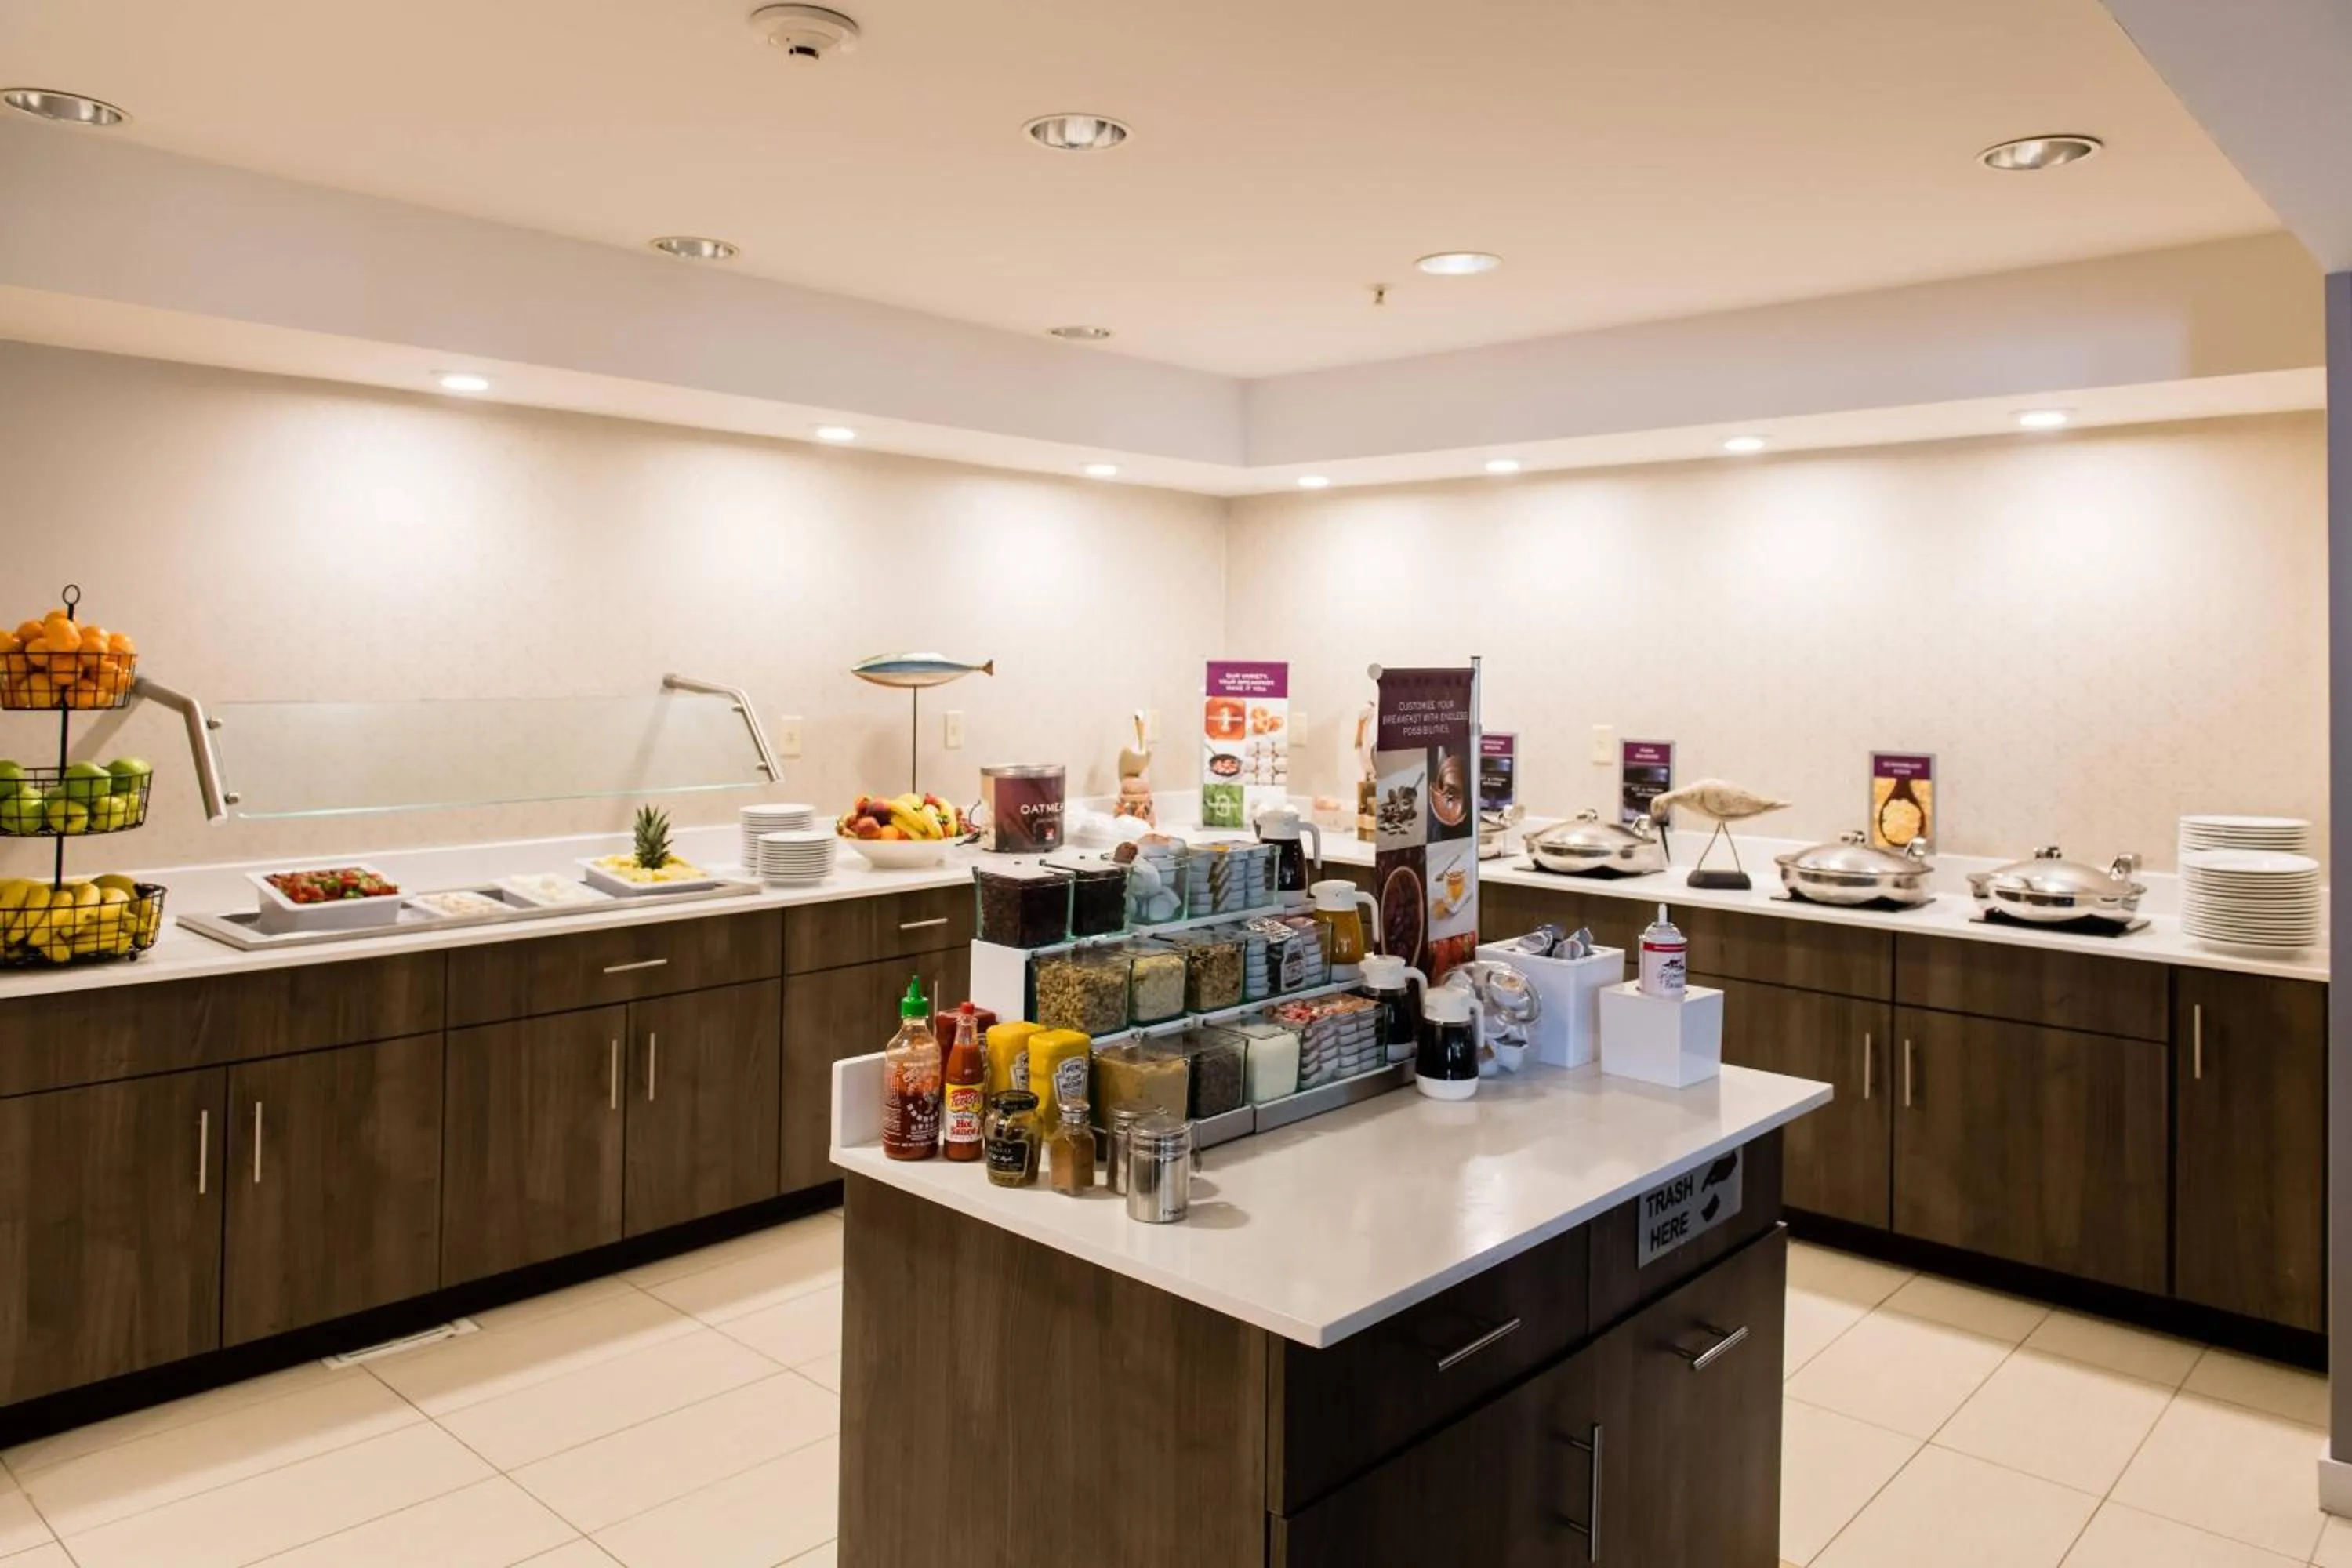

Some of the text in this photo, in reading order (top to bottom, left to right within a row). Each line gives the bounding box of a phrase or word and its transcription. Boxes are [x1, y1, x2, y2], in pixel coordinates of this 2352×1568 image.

[1398, 699, 1454, 712] CUSTOMIZE YOUR
[1382, 710, 1468, 725] BREAKFAST WITH ENDLESS
[1019, 802, 1065, 815] OATME
[1646, 1174, 1693, 1219] TRASH
[1650, 1210, 1689, 1253] HERE
